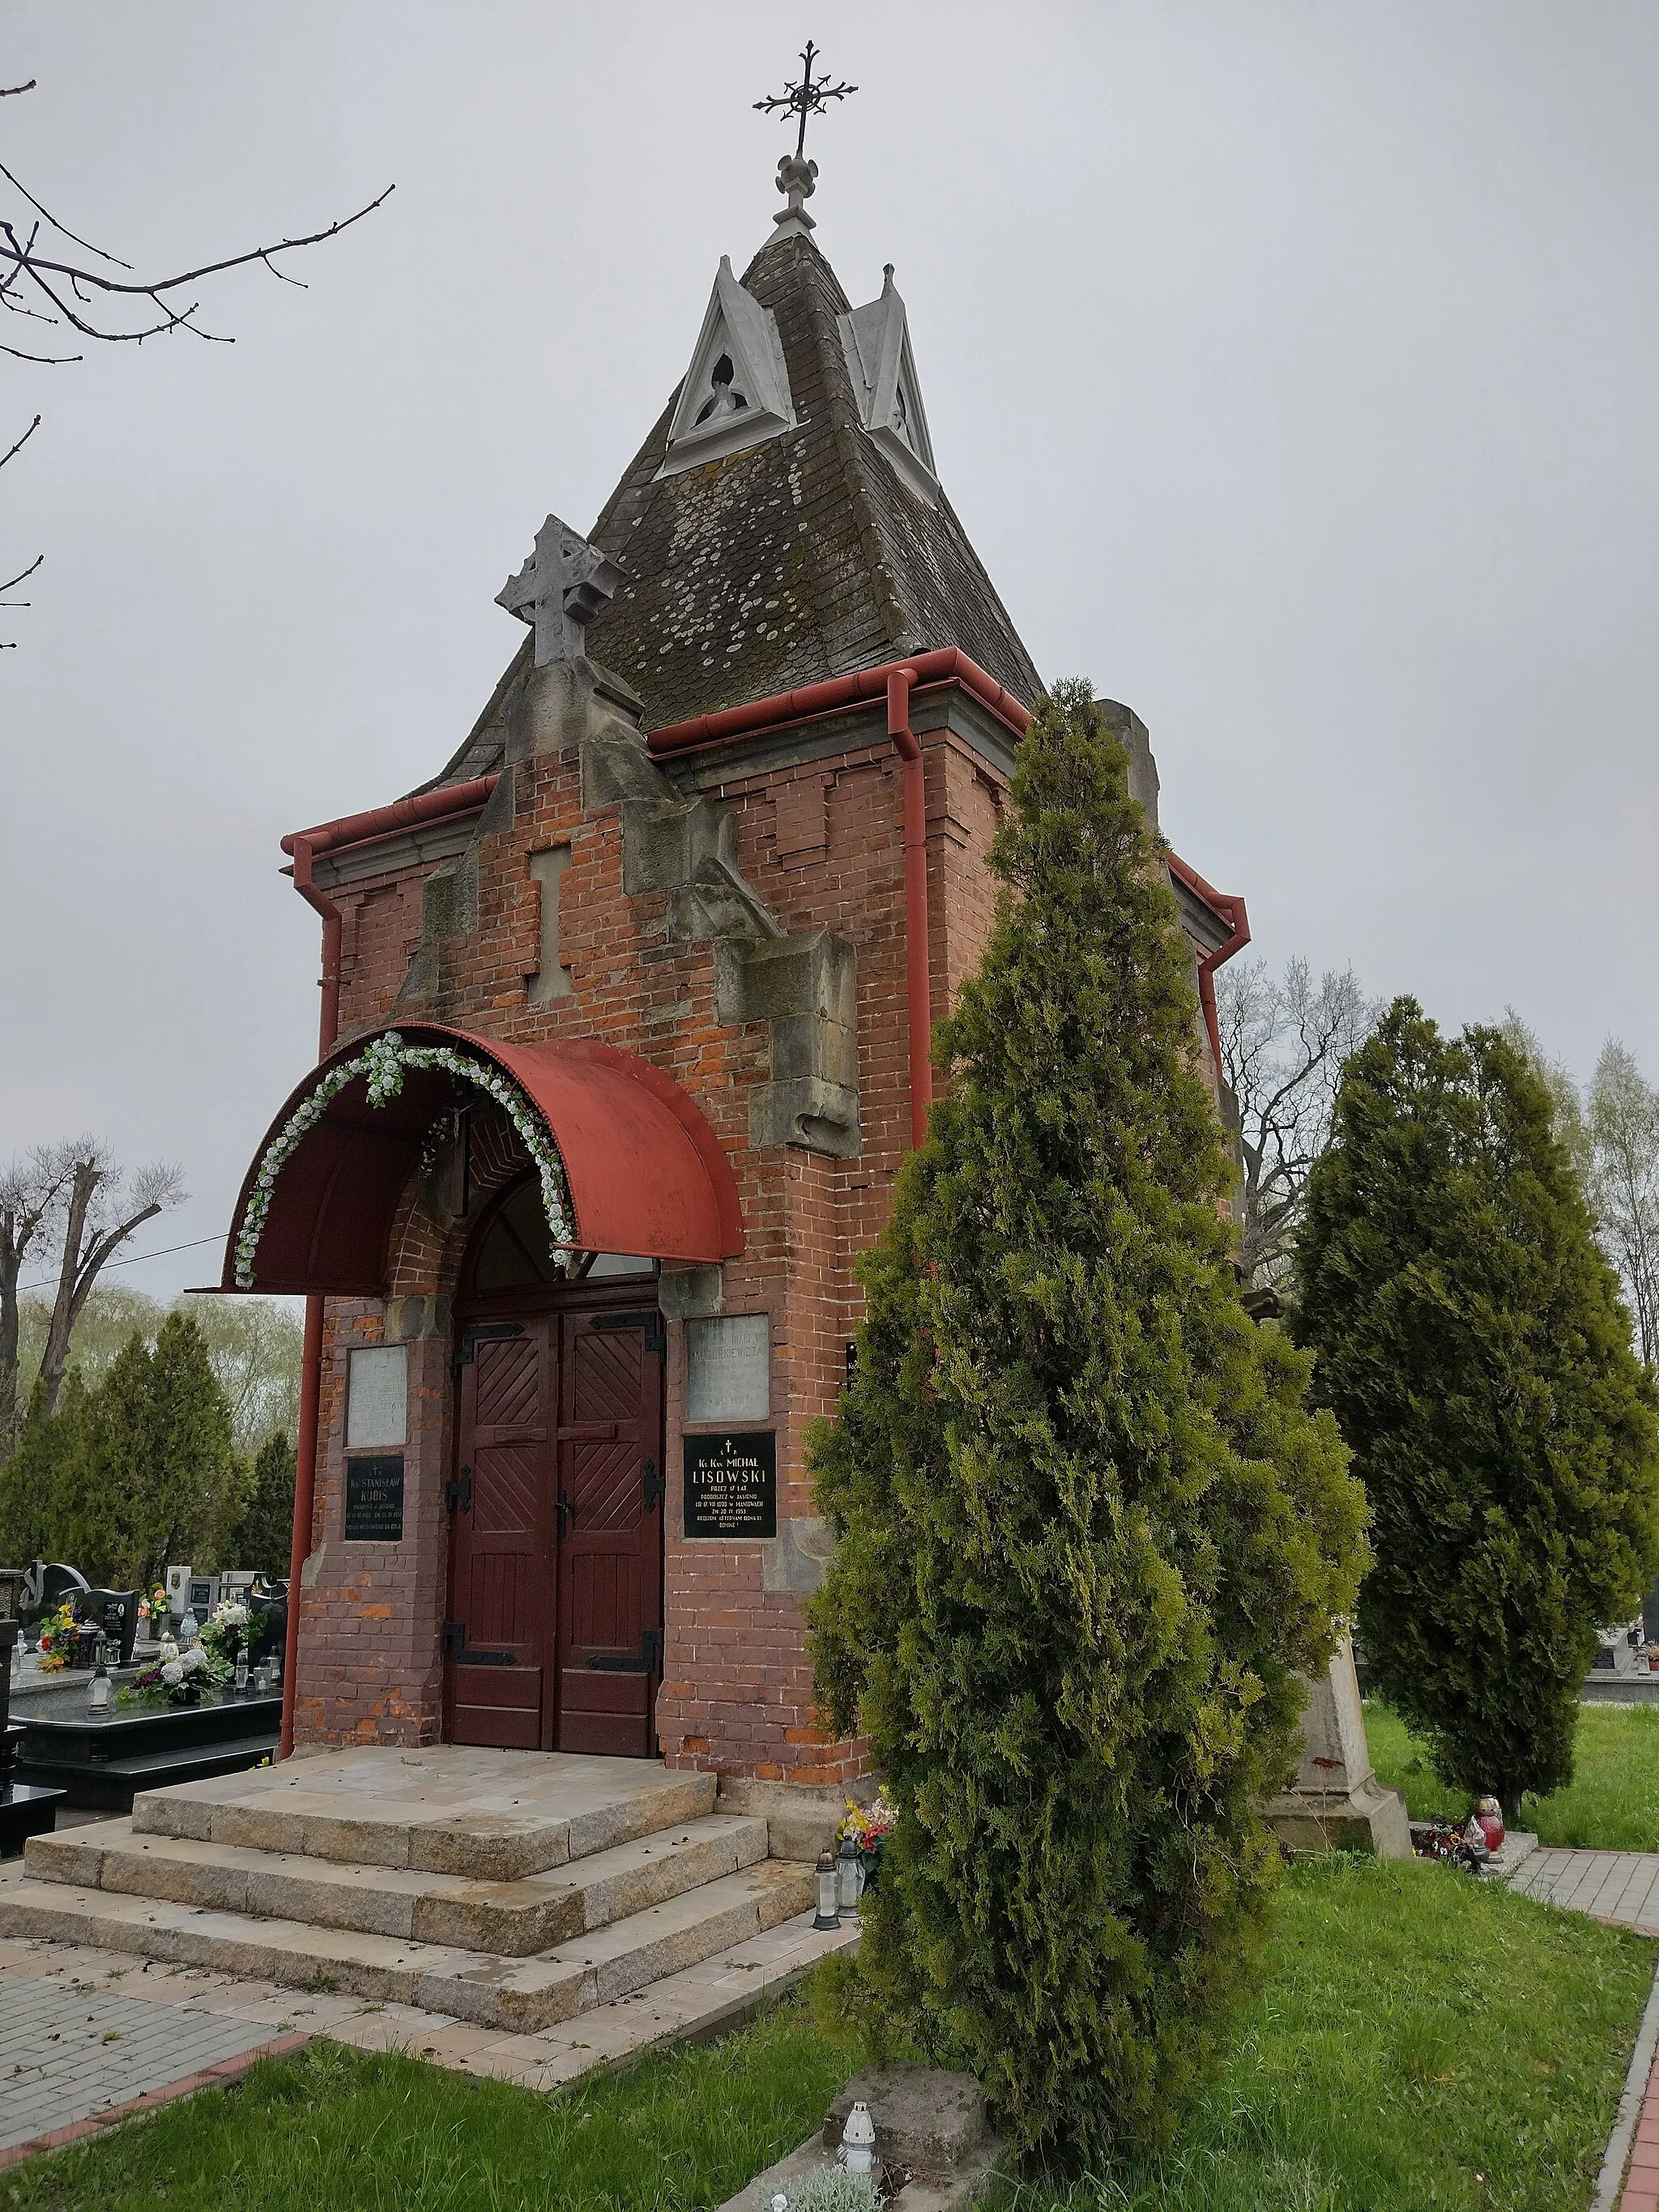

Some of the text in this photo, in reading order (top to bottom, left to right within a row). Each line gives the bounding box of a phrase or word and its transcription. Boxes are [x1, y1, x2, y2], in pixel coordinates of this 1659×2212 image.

[727, 1457, 759, 1468] MICHAŁ
[693, 1469, 766, 1484] LISOWSKI
[361, 1478, 400, 1487] STANISŁAW
